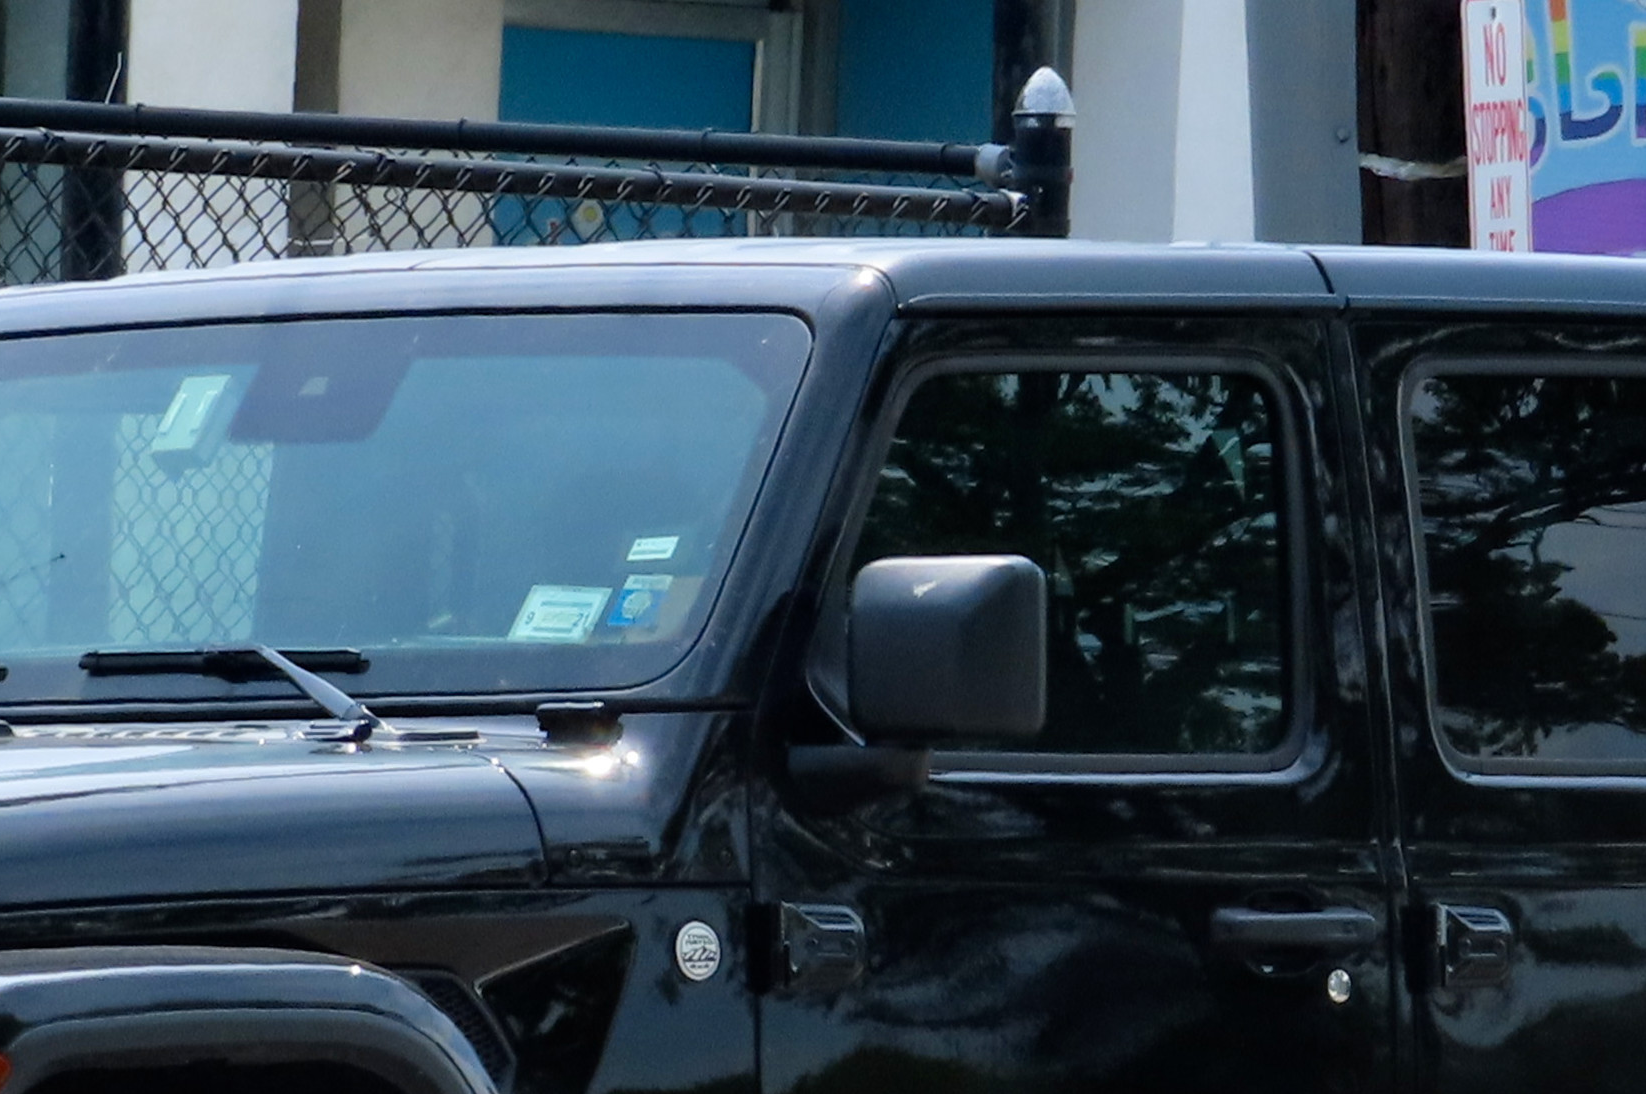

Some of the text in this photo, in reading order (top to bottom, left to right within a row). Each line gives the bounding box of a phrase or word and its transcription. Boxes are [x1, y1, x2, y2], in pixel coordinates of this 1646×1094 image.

[1483, 22, 1506, 87] NO
[1472, 98, 1527, 165] STOPPING
[1489, 175, 1512, 219] ANY
